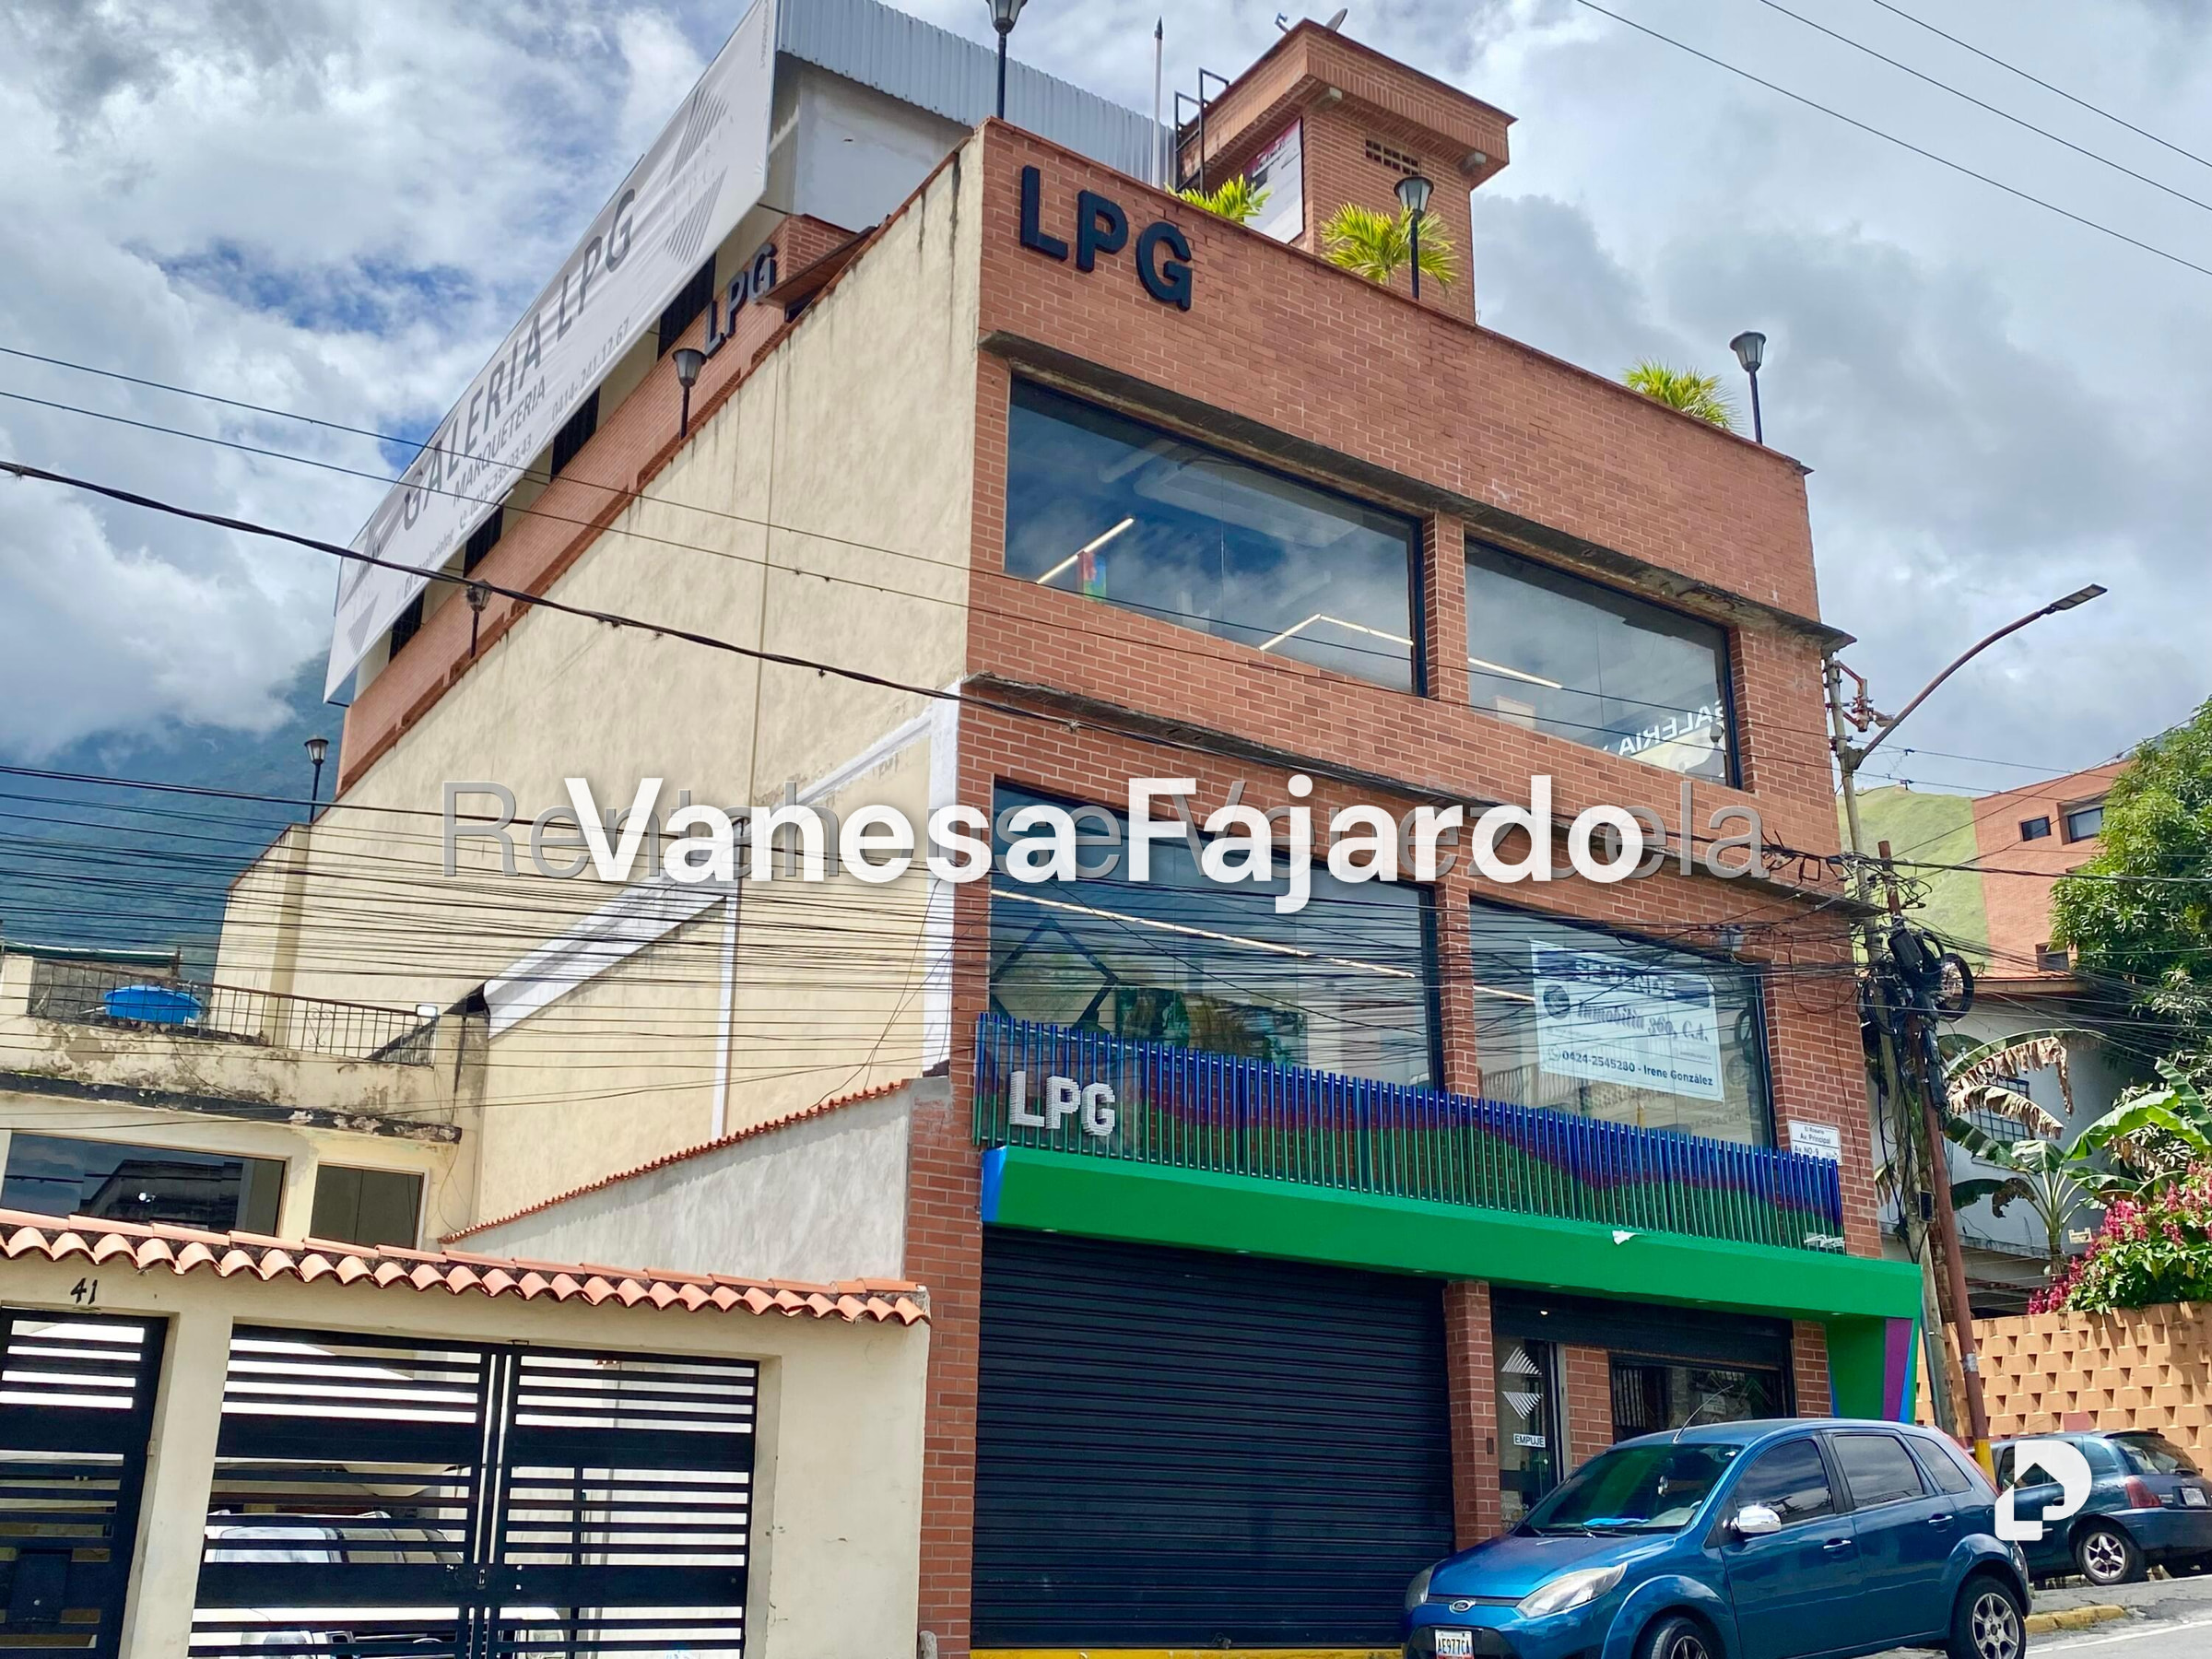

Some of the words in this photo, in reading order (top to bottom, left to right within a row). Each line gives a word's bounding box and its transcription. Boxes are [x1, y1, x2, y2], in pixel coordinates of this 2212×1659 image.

[1020, 165, 1193, 312] LPG
[704, 241, 778, 359] LPG
[404, 312, 542, 532] GALERIA
[557, 188, 636, 343] LPG
[453, 374, 546, 508] MARQUETERIA
[1561, 1050, 1636, 1073] 0424-2545280
[1643, 1065, 1668, 1079] Irene
[1670, 1070, 1714, 1087] González
[1009, 1070, 1116, 1137] LPG
[1808, 1134, 1831, 1145] Principal
[70, 1277, 98, 1305] 41
[1514, 1434, 1545, 1447] EMPUJE
